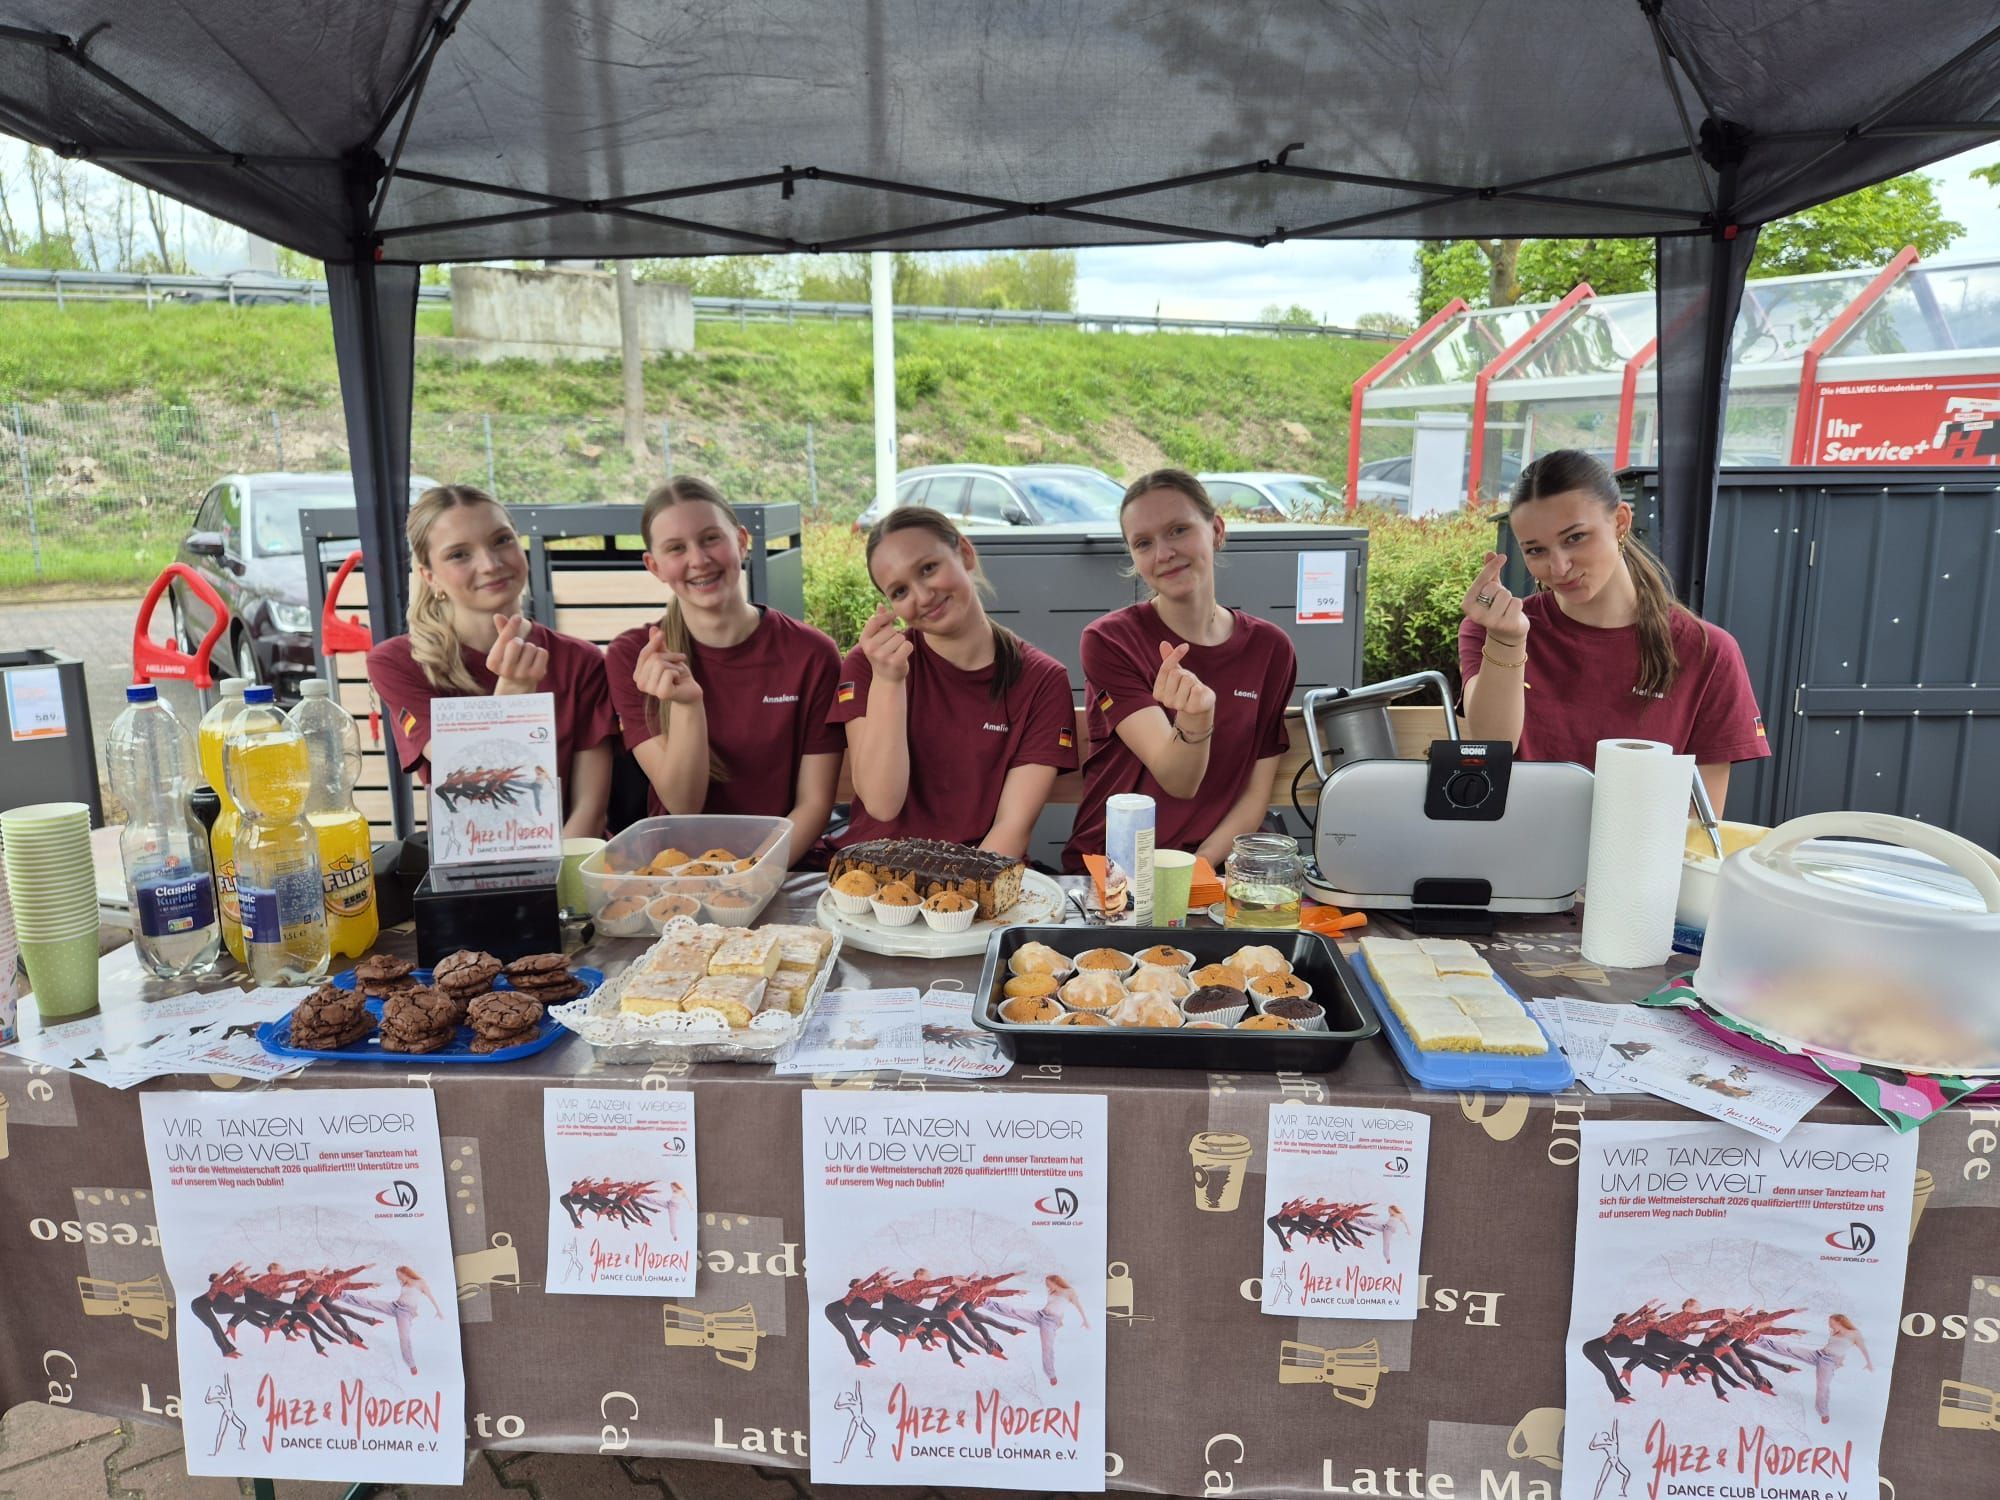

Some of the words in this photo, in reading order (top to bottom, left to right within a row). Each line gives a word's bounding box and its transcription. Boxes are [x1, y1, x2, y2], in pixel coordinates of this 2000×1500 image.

[1835, 385, 1876, 395] HELLWEG
[1878, 383, 1933, 393] Kundenkarte
[1827, 419, 1862, 438] Ihr
[322, 860, 370, 892] FLIRT
[156, 882, 196, 896] Classic
[364, 1150, 402, 1159] Tanzteam
[983, 1155, 1003, 1163] denn
[1029, 1156, 1068, 1164] Tanzteam
[1070, 1156, 1083, 1164] hat
[186, 1165, 197, 1173] für
[211, 1165, 280, 1174] Weltmeisterschaft
[357, 1162, 403, 1171] Unterstütze
[843, 1165, 854, 1173] für
[856, 1165, 868, 1174] die
[870, 1166, 942, 1174] Weltmeisterschaft
[944, 1167, 963, 1175] 2026
[1020, 1168, 1066, 1176] Unterstütze
[218, 1178, 235, 1188] Weg
[237, 1178, 255, 1186] nach
[256, 1178, 284, 1186] Dublin!
[876, 1179, 893, 1188] Weg
[916, 1179, 944, 1187] Dublin!
[1773, 1186, 1796, 1195] denn
[1798, 1188, 1823, 1197] unser
[1825, 1188, 1868, 1198] Tanzteam
[1870, 1189, 1886, 1198] hat
[1600, 1197, 1617, 1205] sich
[1619, 1196, 1631, 1205] für
[1633, 1196, 1646, 1205] die
[1648, 1195, 1725, 1205] Weltmeisterschaft
[1728, 1197, 1749, 1206] 2026
[1813, 1200, 1865, 1211] Unterstütze
[1867, 1203, 1884, 1212] uns
[1599, 1210, 1612, 1219] auf
[1652, 1209, 1671, 1220] Weg
[1673, 1209, 1693, 1217] nach
[1695, 1209, 1727, 1218] Dublin!
[1323, 1459, 1455, 1500] Latte
[1668, 1485, 1714, 1497] DANCE
[1719, 1487, 1755, 1498] CLUB
[1761, 1488, 1819, 1500] LOHMAR
